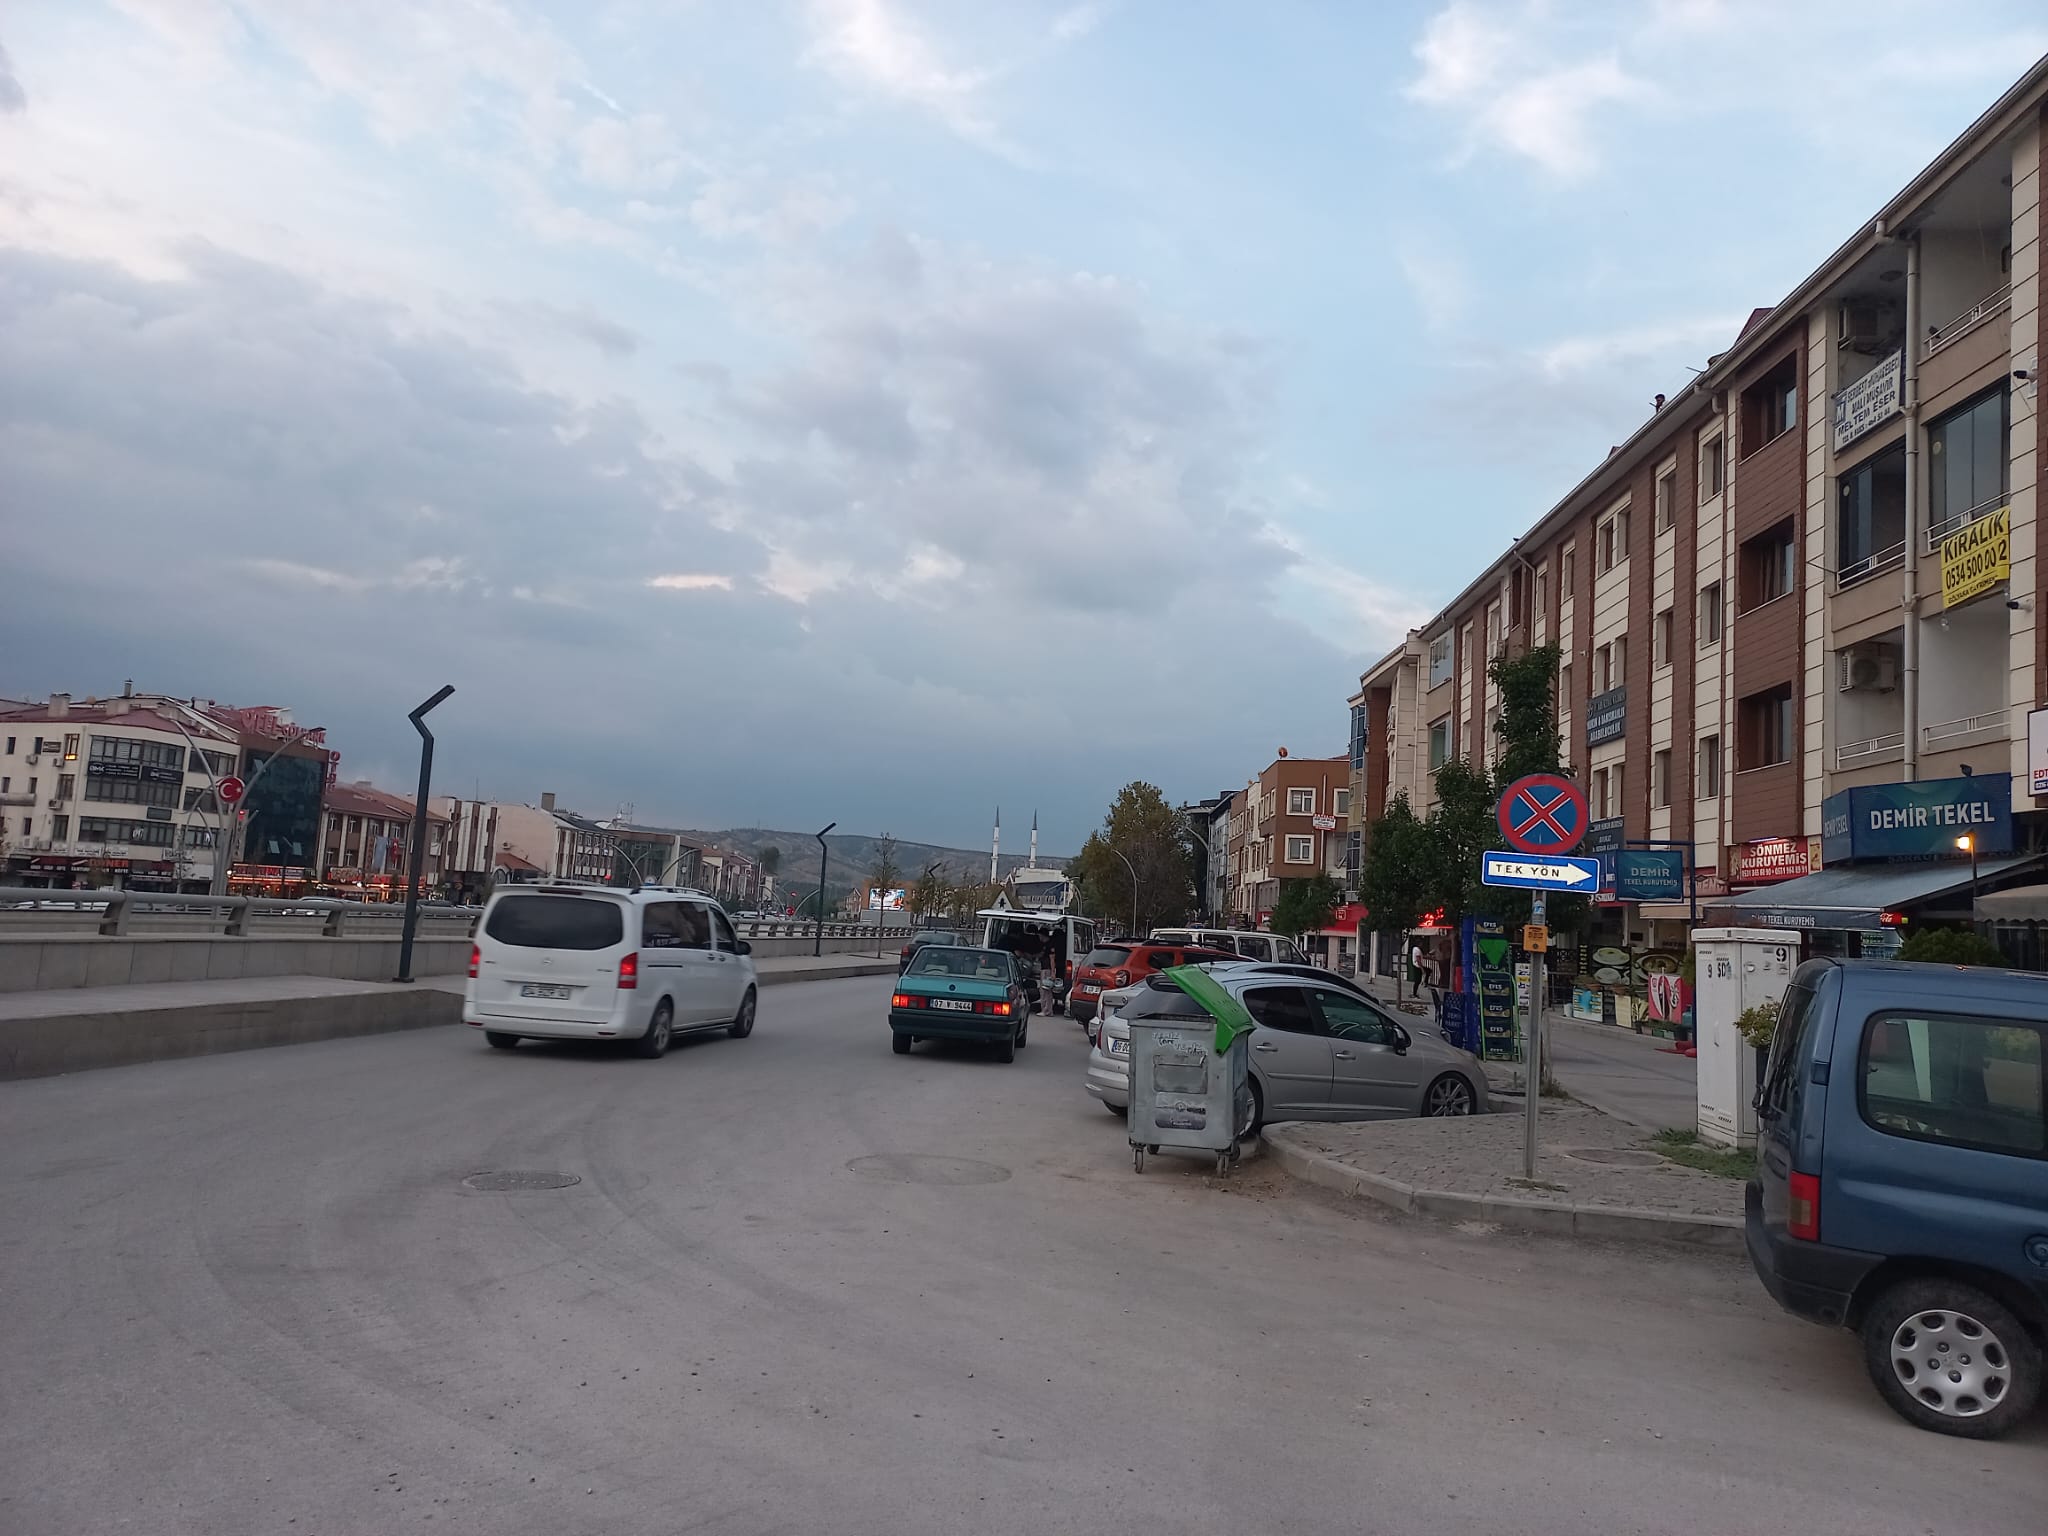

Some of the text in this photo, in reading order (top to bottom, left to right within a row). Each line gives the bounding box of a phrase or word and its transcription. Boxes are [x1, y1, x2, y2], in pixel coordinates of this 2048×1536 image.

[1838, 407, 1870, 437] MELTEM
[1872, 390, 1896, 412] ESER
[1946, 562, 1966, 590] 0534
[1966, 553, 1983, 579] 500
[1871, 801, 1996, 830] DEMİR TEKEL
[1750, 842, 1797, 857] SÖNMEZ
[1496, 864, 1560, 877] TEK YÖN
[1768, 914, 1783, 925] TEKEL
[1776, 948, 1787, 962] 9
[1707, 963, 1713, 978] 9
